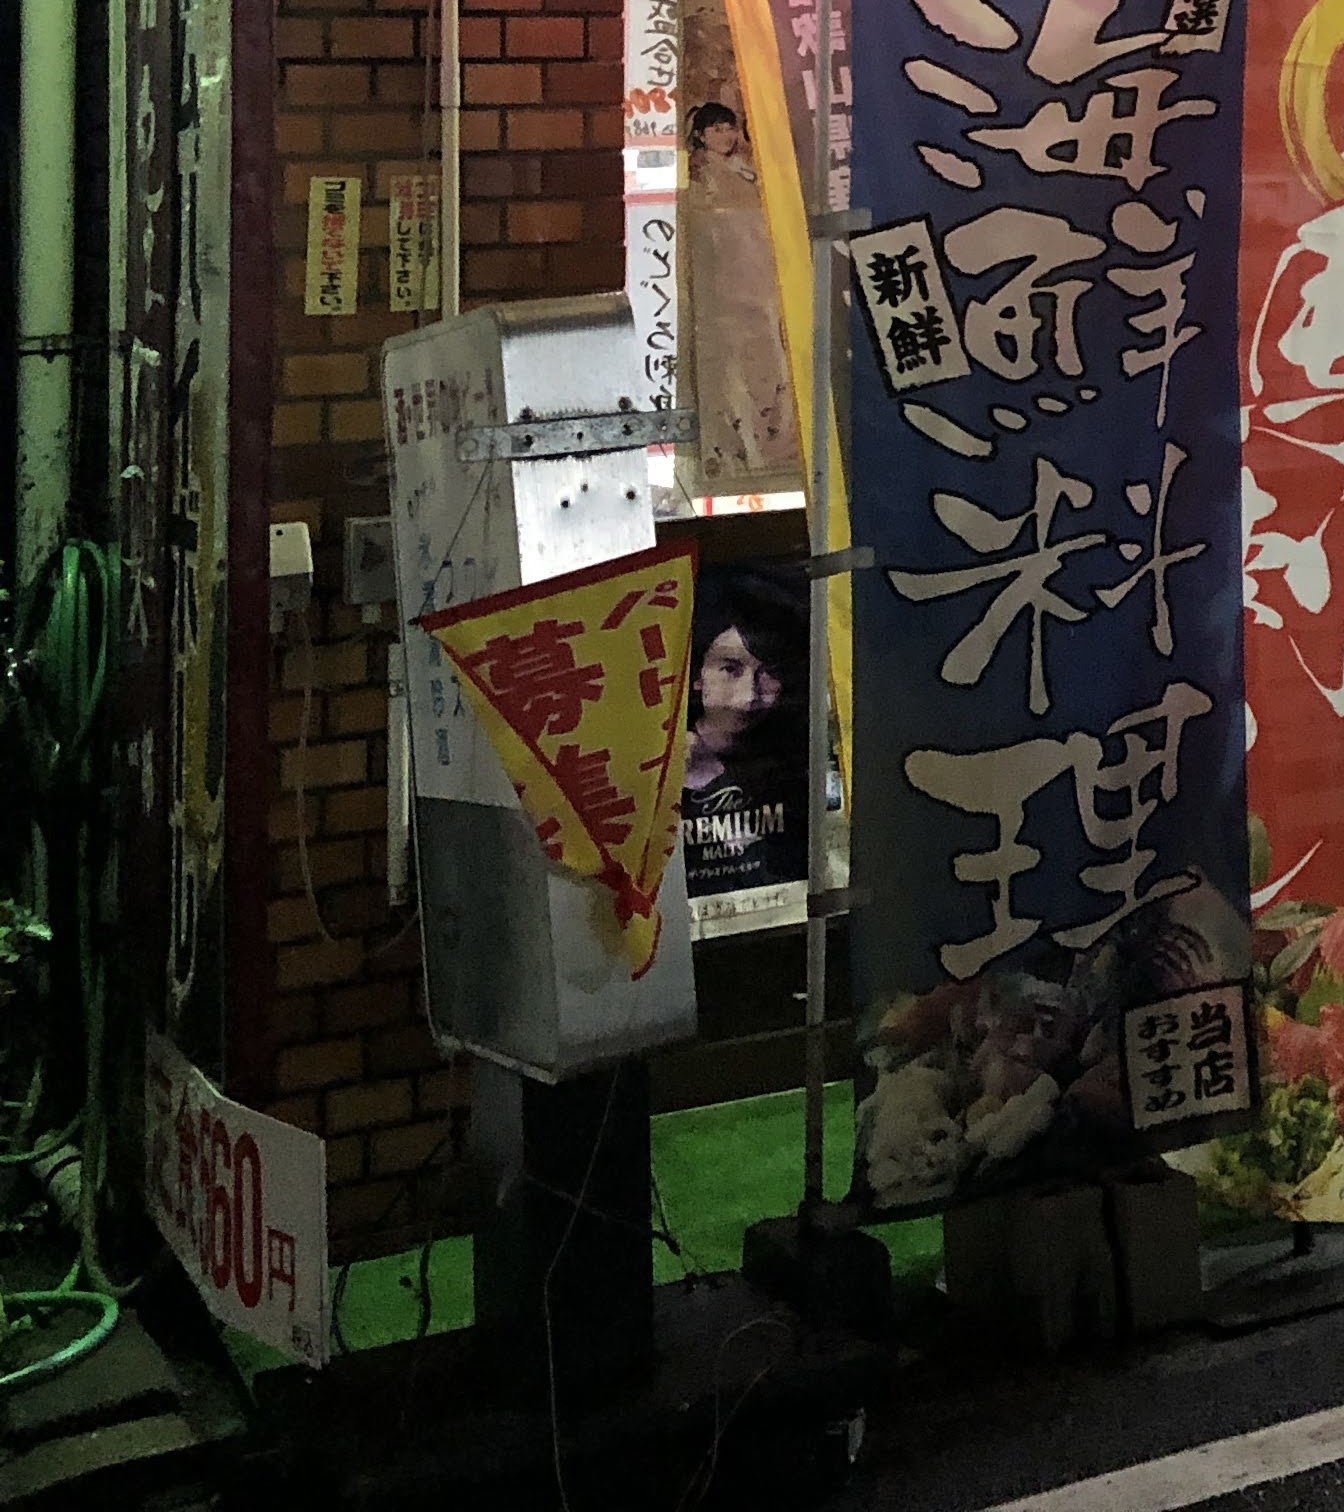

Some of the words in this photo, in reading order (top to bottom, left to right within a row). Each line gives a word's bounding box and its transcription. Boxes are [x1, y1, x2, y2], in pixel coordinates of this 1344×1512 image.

[866, 243, 952, 374] 新鮮
[681, 802, 785, 845] REMIUM
[702, 841, 745, 861] MALTS
[1137, 1011, 1187, 1112] おすすめ
[1186, 1002, 1234, 1102] 当店
